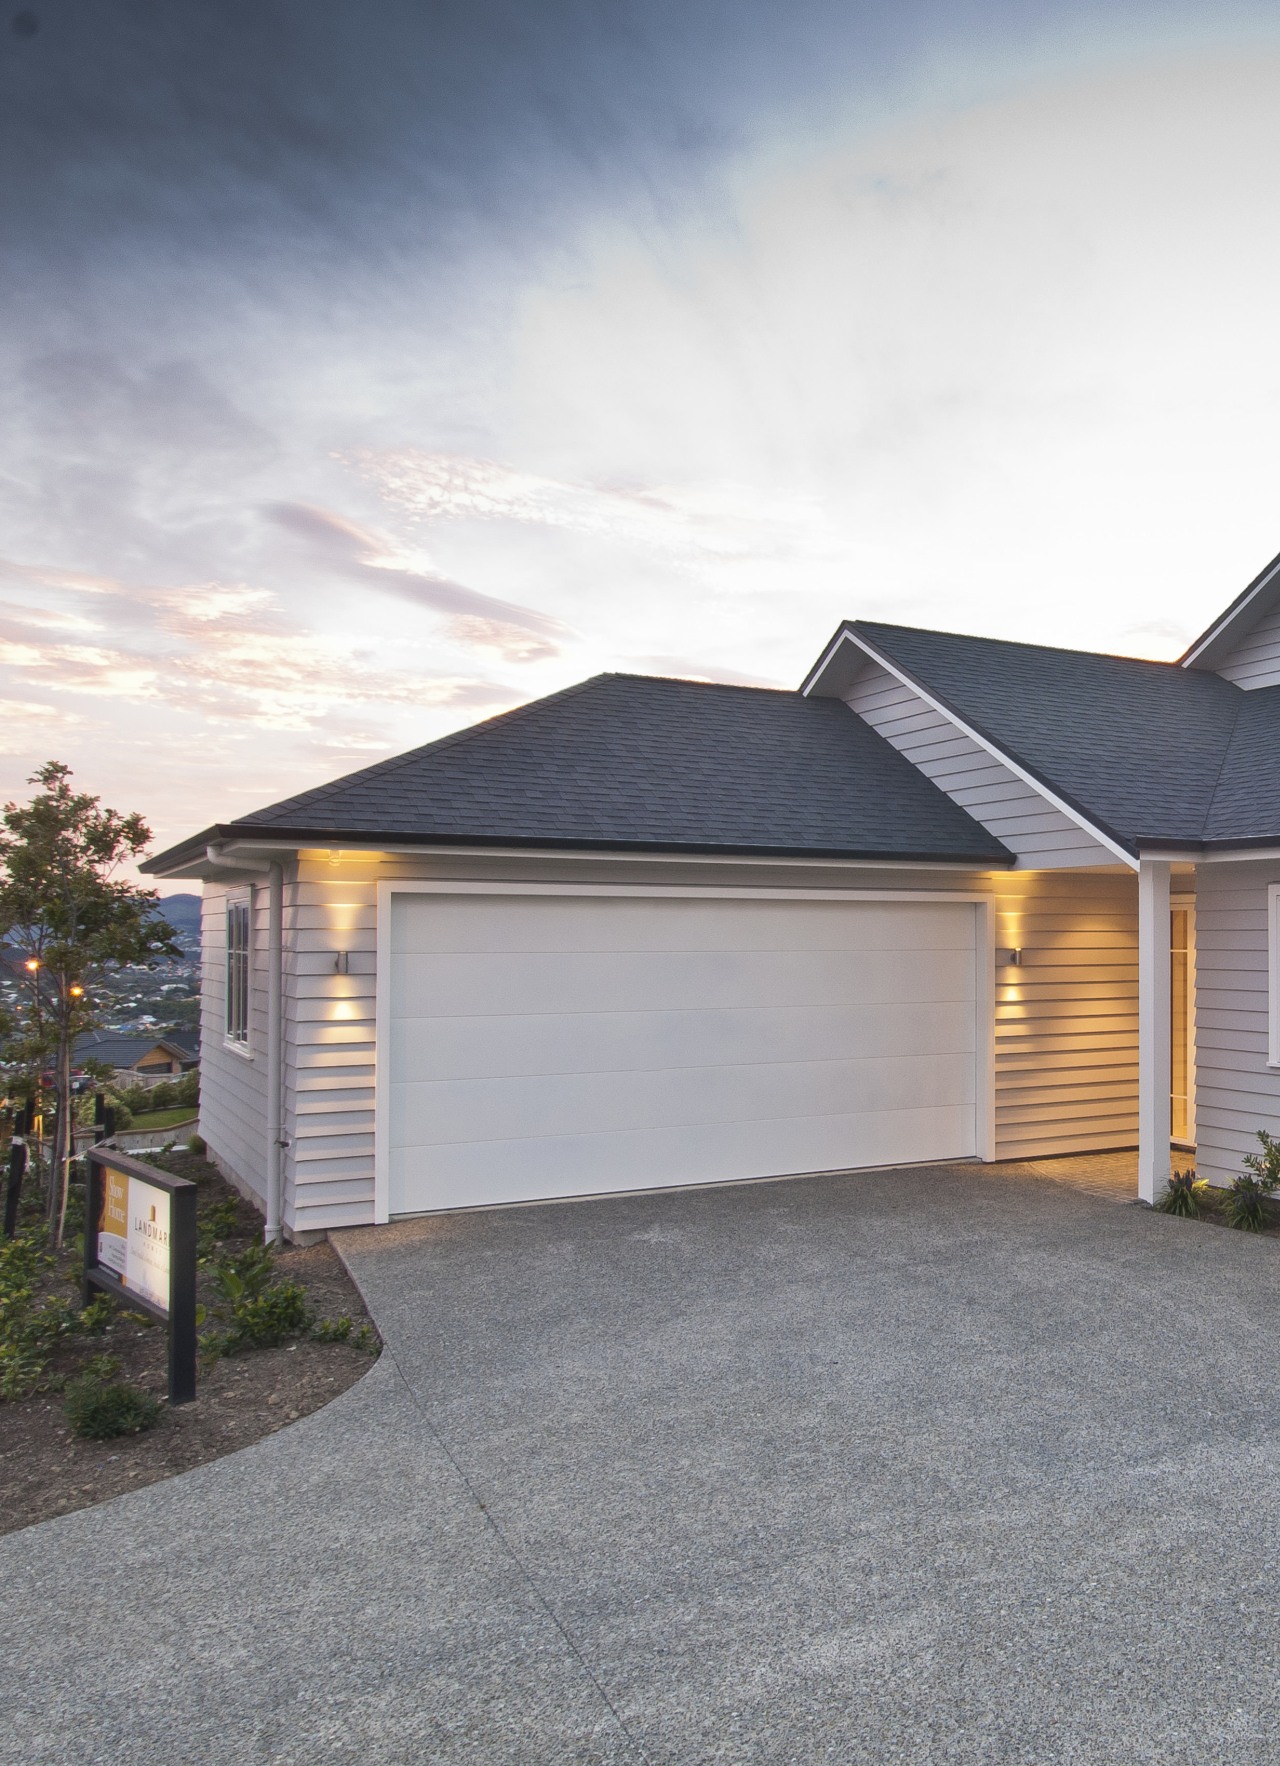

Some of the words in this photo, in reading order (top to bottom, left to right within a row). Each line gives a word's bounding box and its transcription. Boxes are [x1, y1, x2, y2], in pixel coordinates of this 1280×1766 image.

[109, 1175, 124, 1199] Show
[108, 1196, 125, 1223] Home
[134, 1216, 168, 1247] LANDMAR
